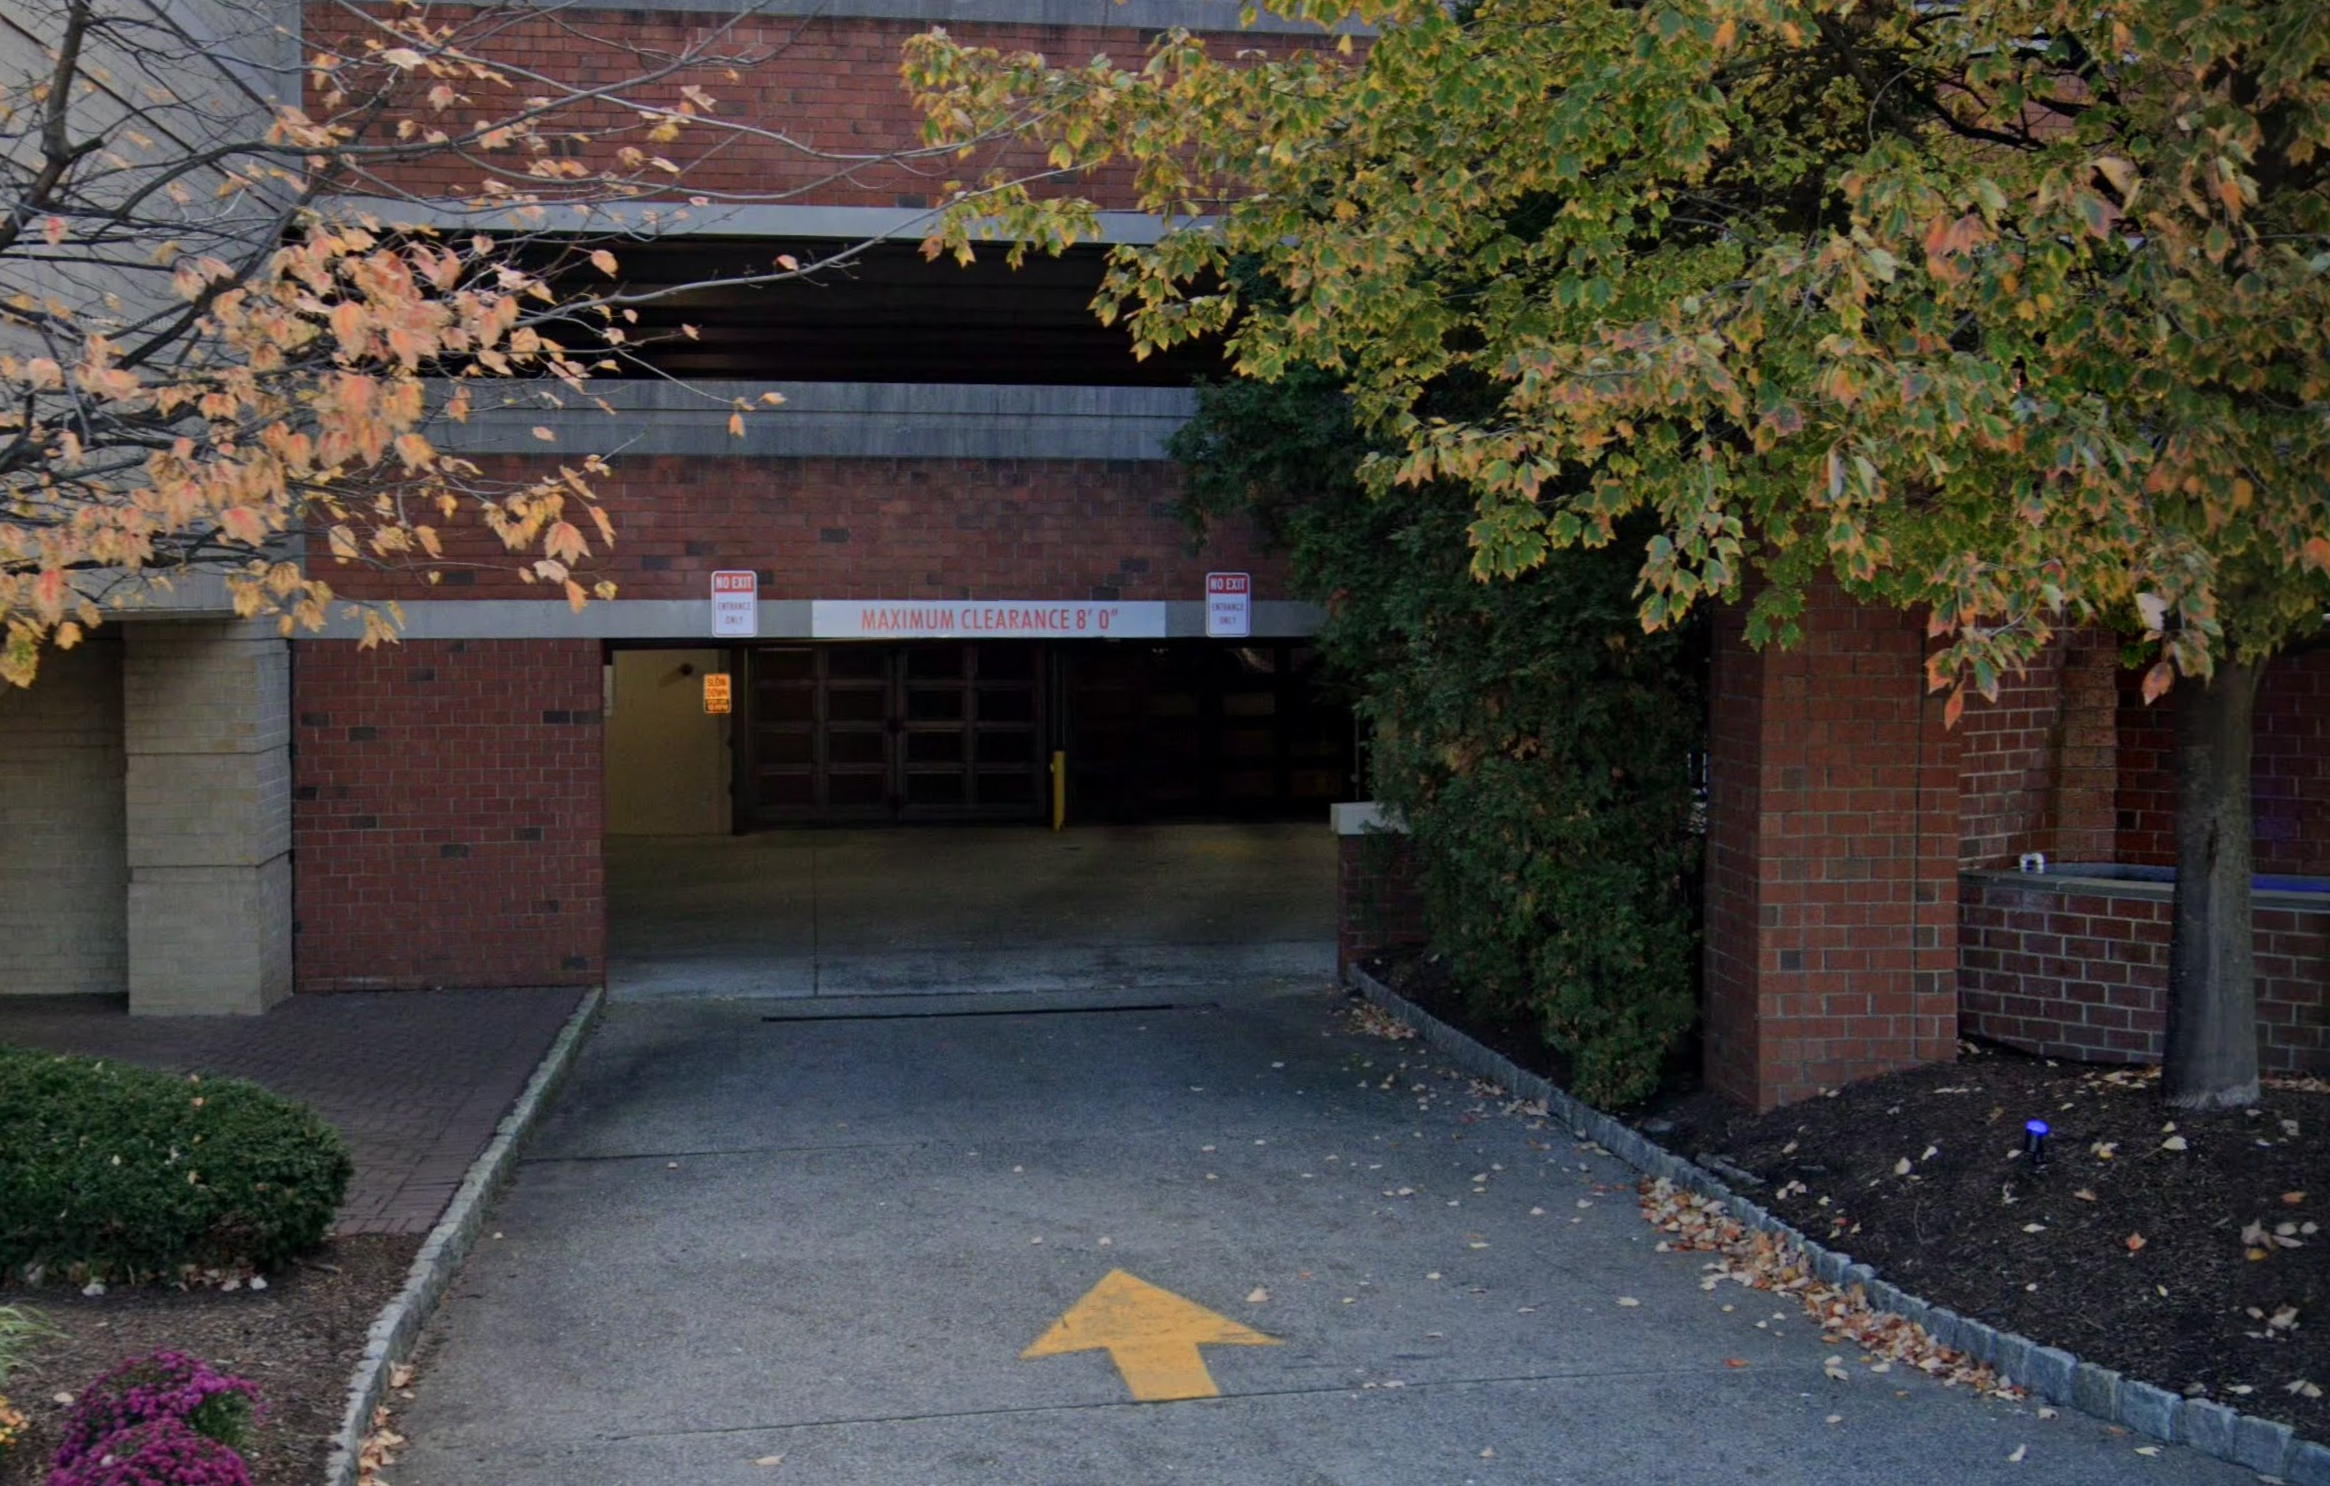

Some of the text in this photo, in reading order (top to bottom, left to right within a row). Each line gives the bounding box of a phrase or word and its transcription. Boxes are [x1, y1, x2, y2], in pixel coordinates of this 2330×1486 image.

[715, 575, 753, 589] NO EXIT
[1210, 577, 1246, 590] NO EXIT
[717, 602, 751, 611] ENTRANCE
[1211, 602, 1245, 611] ENTRANCE
[725, 616, 743, 625] ONLY
[861, 608, 955, 630] MAXIMUM
[961, 608, 1070, 631] CLEARANCE
[1219, 616, 1237, 625] ONLY
[707, 677, 727, 687] SLOW
